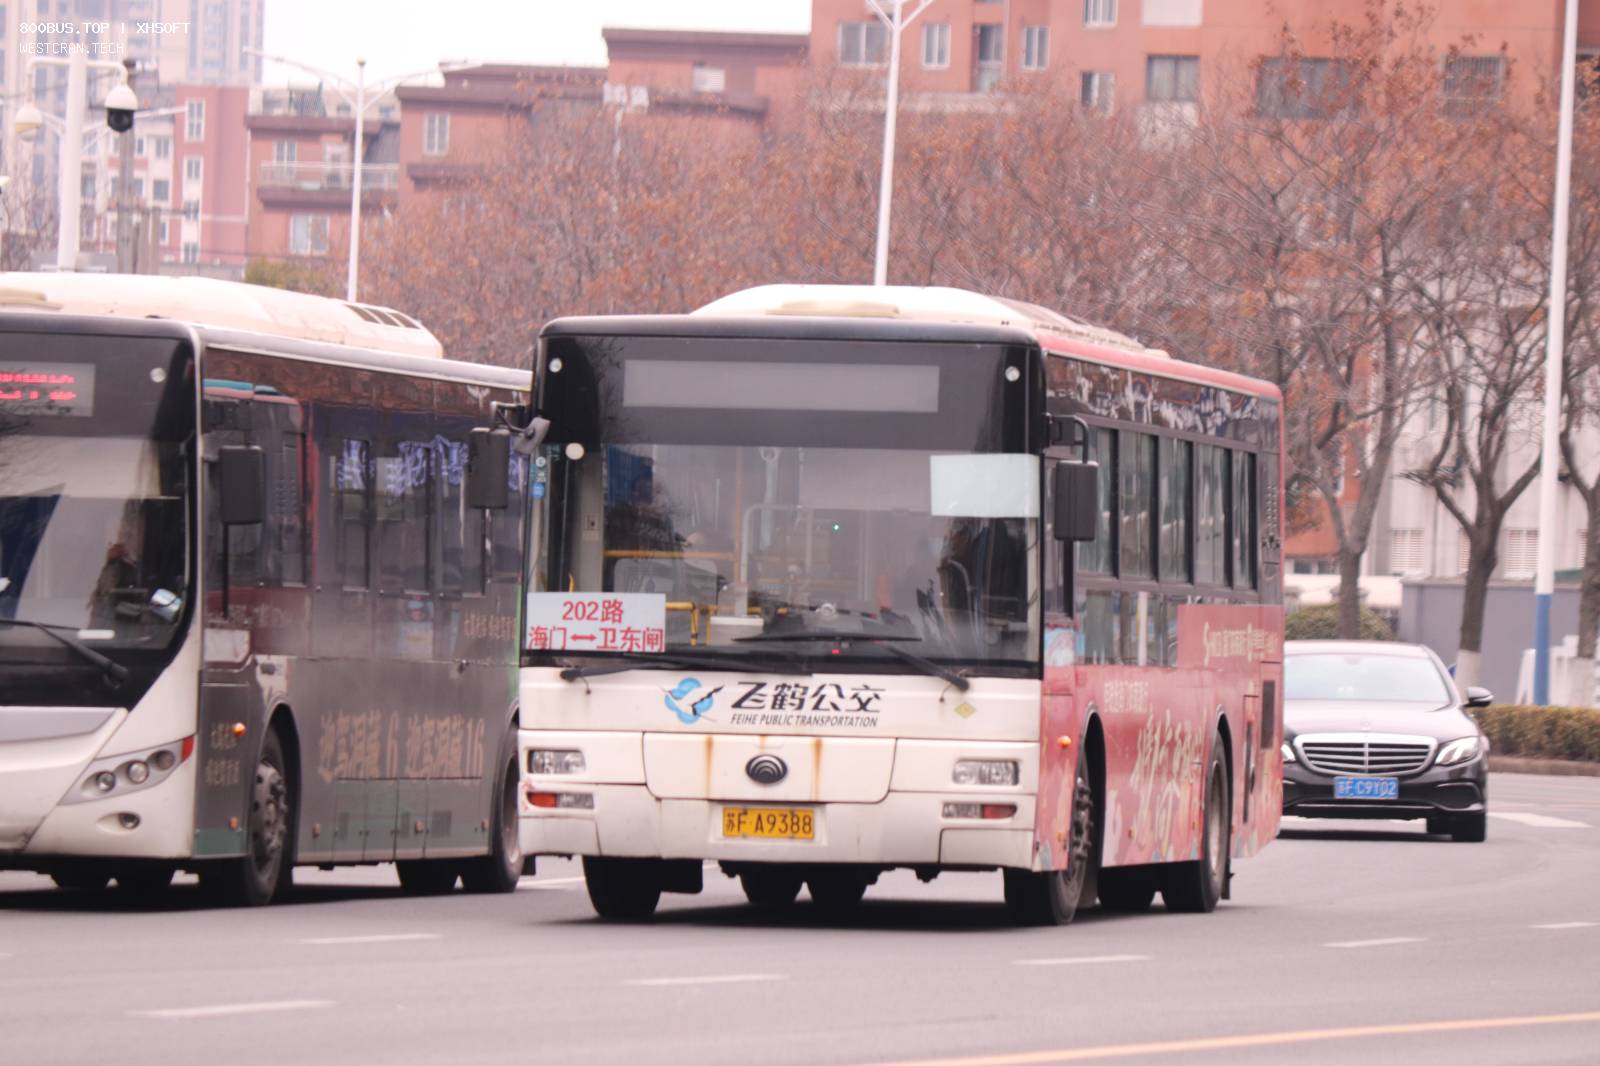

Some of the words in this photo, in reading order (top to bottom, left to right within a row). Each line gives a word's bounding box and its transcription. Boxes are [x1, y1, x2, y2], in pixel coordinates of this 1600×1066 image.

[561, 599, 624, 624] 202路
[528, 625, 568, 651] 海门
[596, 626, 664, 653] 卫东闸
[731, 681, 886, 713] 飞鹤公交
[730, 713, 758, 724] FEIHE
[759, 714, 795, 726] PUBLIC
[795, 715, 878, 728] TRANSPORTATION
